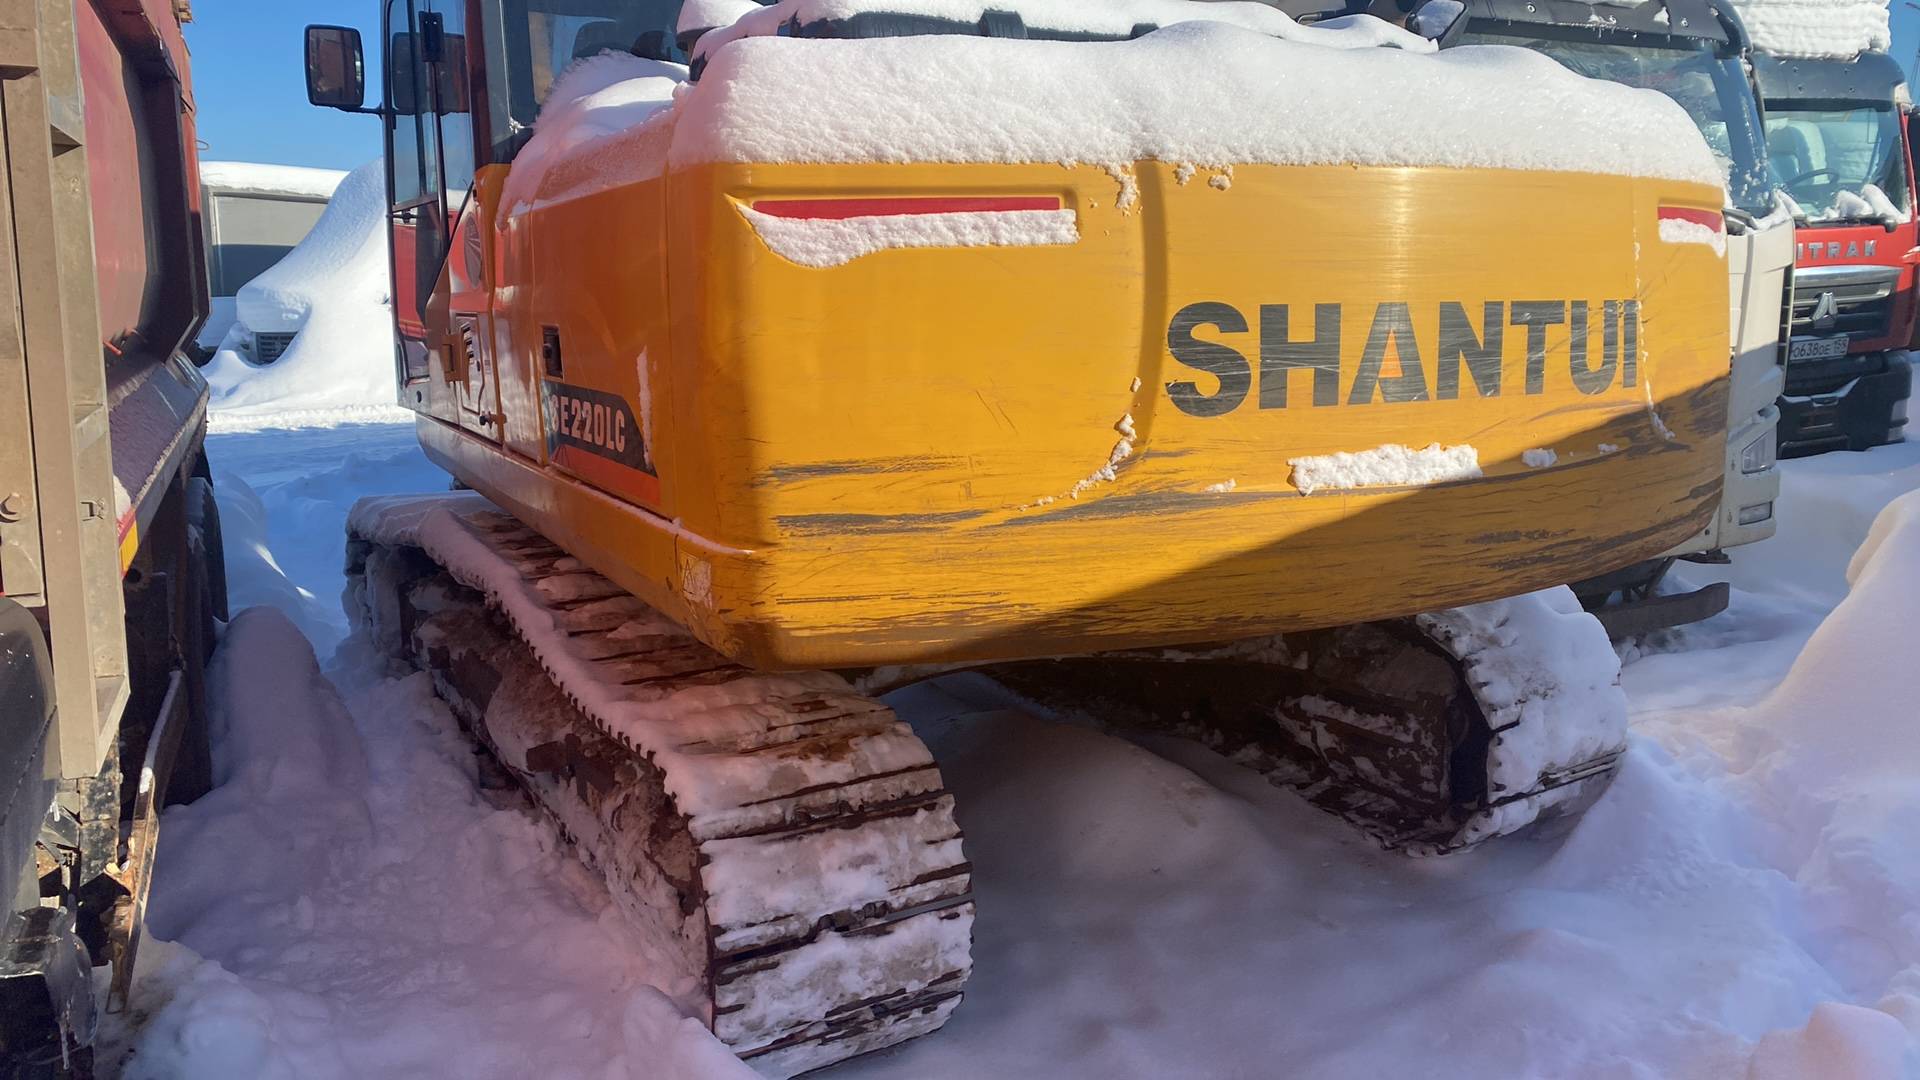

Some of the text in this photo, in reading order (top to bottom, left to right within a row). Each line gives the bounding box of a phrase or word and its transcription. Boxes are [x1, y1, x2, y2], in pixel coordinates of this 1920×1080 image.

[1797, 240, 1877, 260] ITRAK
[1165, 300, 1638, 418] SHANTUI
[548, 394, 625, 453] SE220LC
